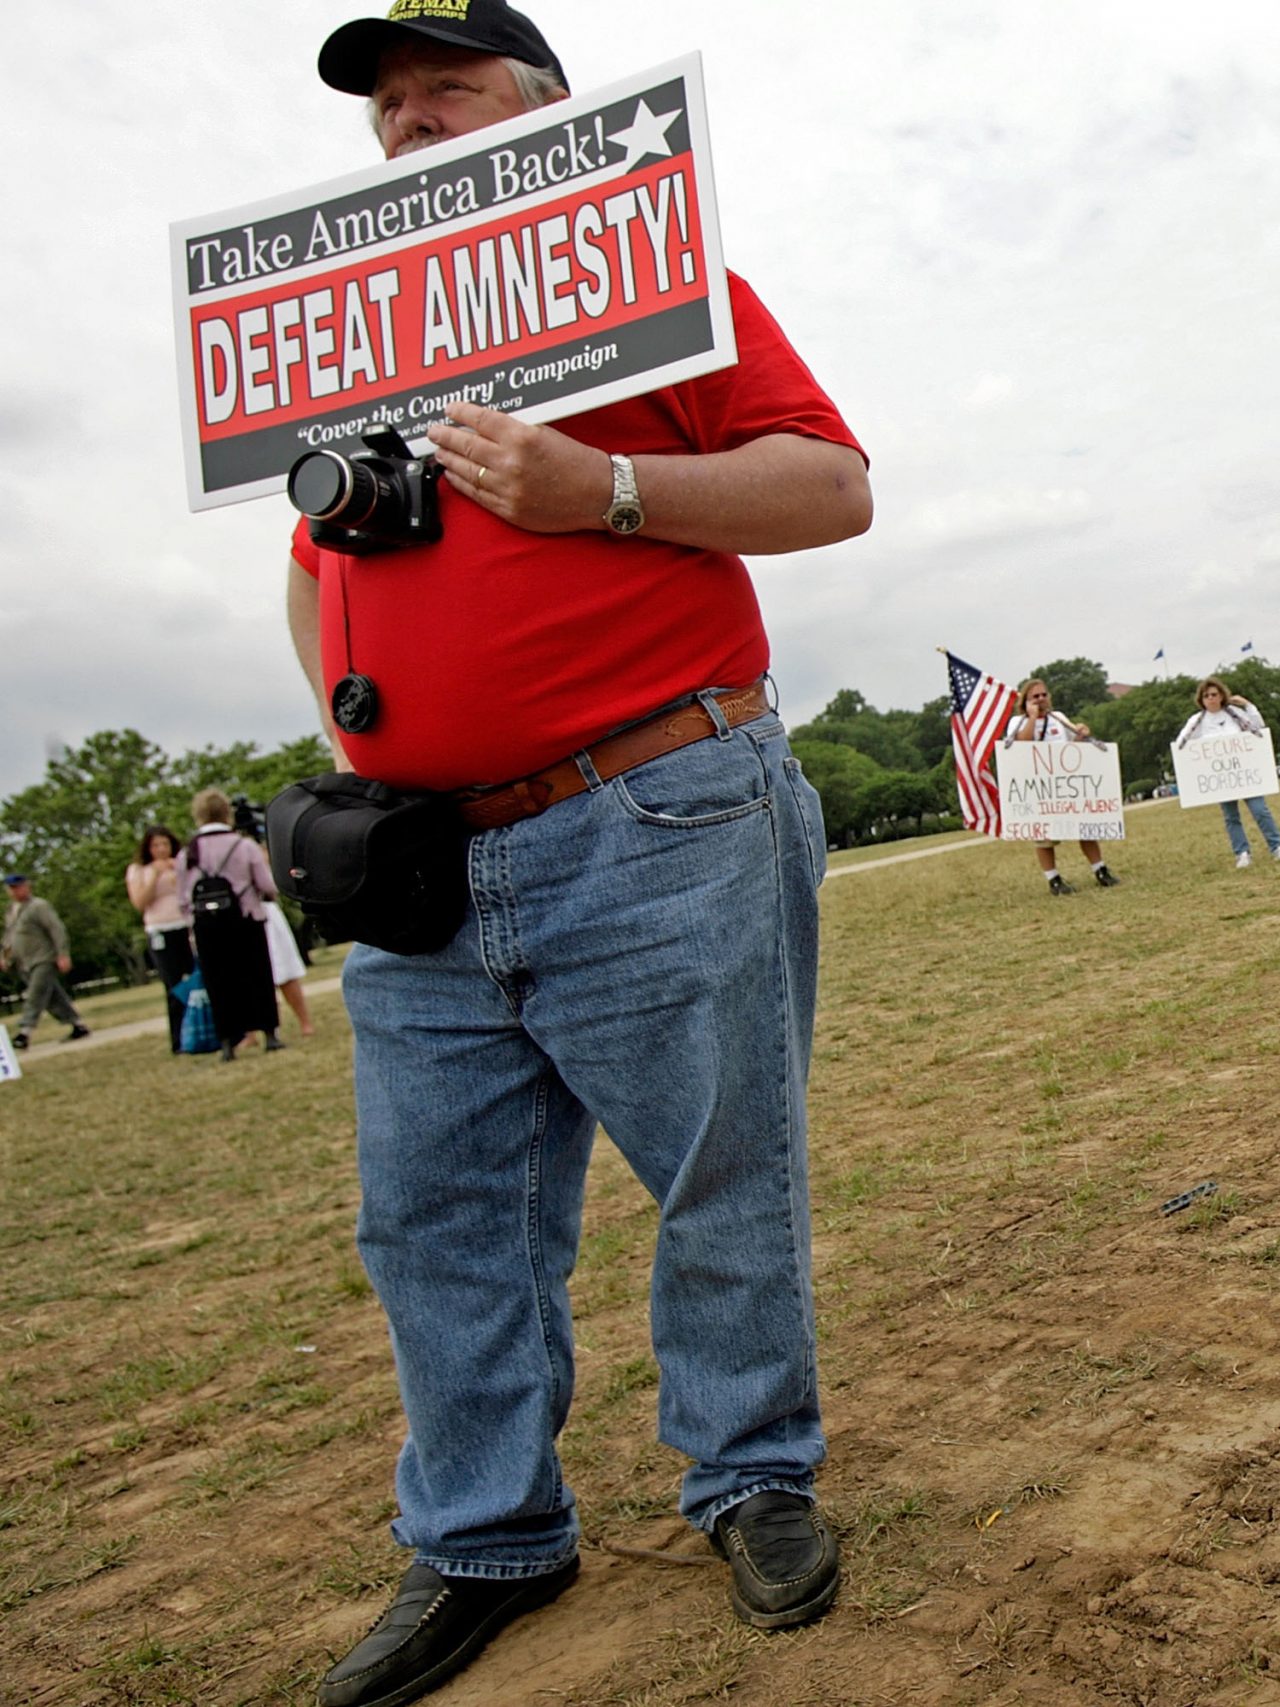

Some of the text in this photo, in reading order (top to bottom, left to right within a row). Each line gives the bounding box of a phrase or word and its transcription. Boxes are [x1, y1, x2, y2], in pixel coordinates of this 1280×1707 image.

[423, 9, 467, 21] CORPS
[189, 116, 609, 289] Take America Back!
[200, 171, 698, 426] DEFEAT AMNESTY!
[297, 418, 373, 447] “Cover
[372, 404, 404, 428] the
[509, 343, 618, 390] Campaign
[1032, 743, 1082, 775] NO
[1189, 735, 1253, 761] SECURE
[1211, 756, 1241, 772] OUR
[1008, 774, 1103, 802] AMNESTY
[1196, 768, 1263, 794] BORDERS
[1039, 800, 1081, 815] ILLEGAL
[1083, 798, 1119, 813] ALIENS
[1006, 822, 1050, 840] SECURE
